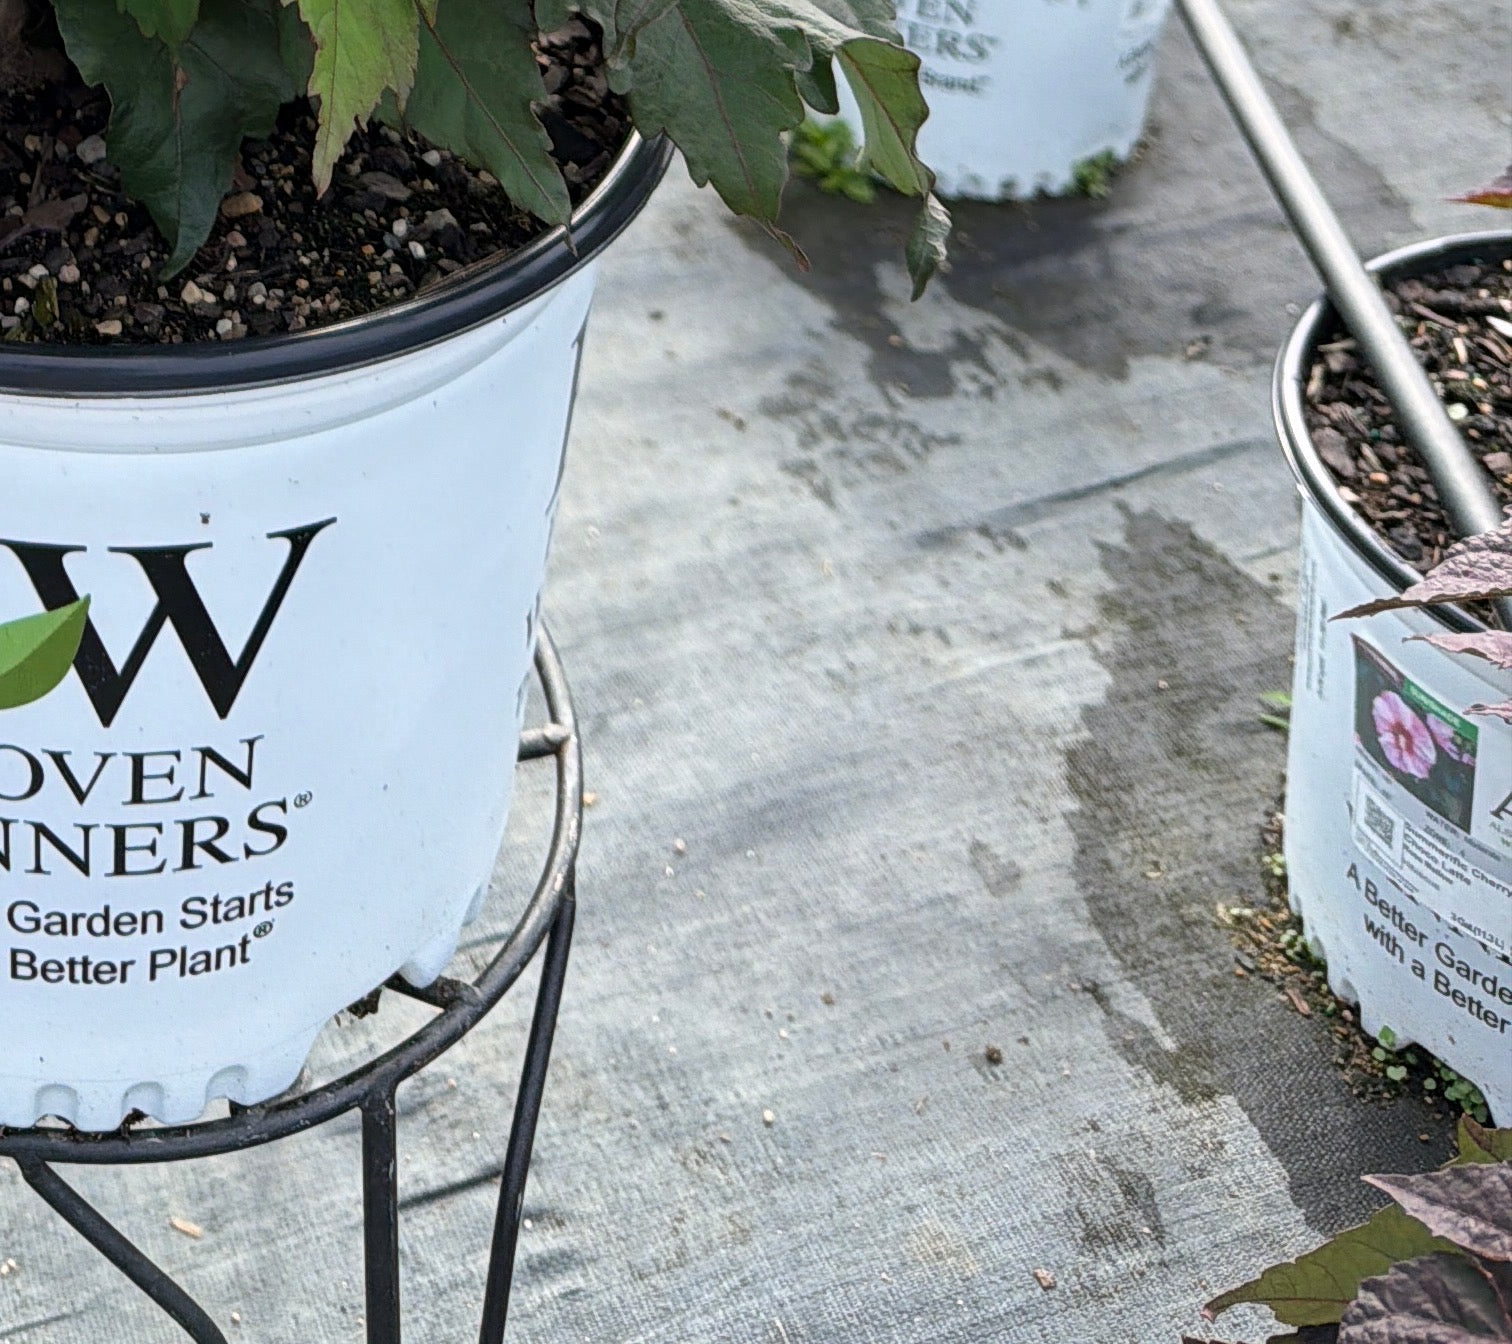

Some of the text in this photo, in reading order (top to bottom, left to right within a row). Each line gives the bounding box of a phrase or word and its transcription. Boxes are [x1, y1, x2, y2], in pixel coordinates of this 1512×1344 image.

[6, 900, 164, 937] Garden
[179, 879, 295, 930] Starts
[1471, 867, 1512, 898] Cherry
[1346, 862, 1362, 891] A
[1364, 877, 1429, 948] Better
[1434, 941, 1512, 1006] Garde
[9, 948, 136, 985] Better
[1363, 913, 1512, 1034] with a Better
